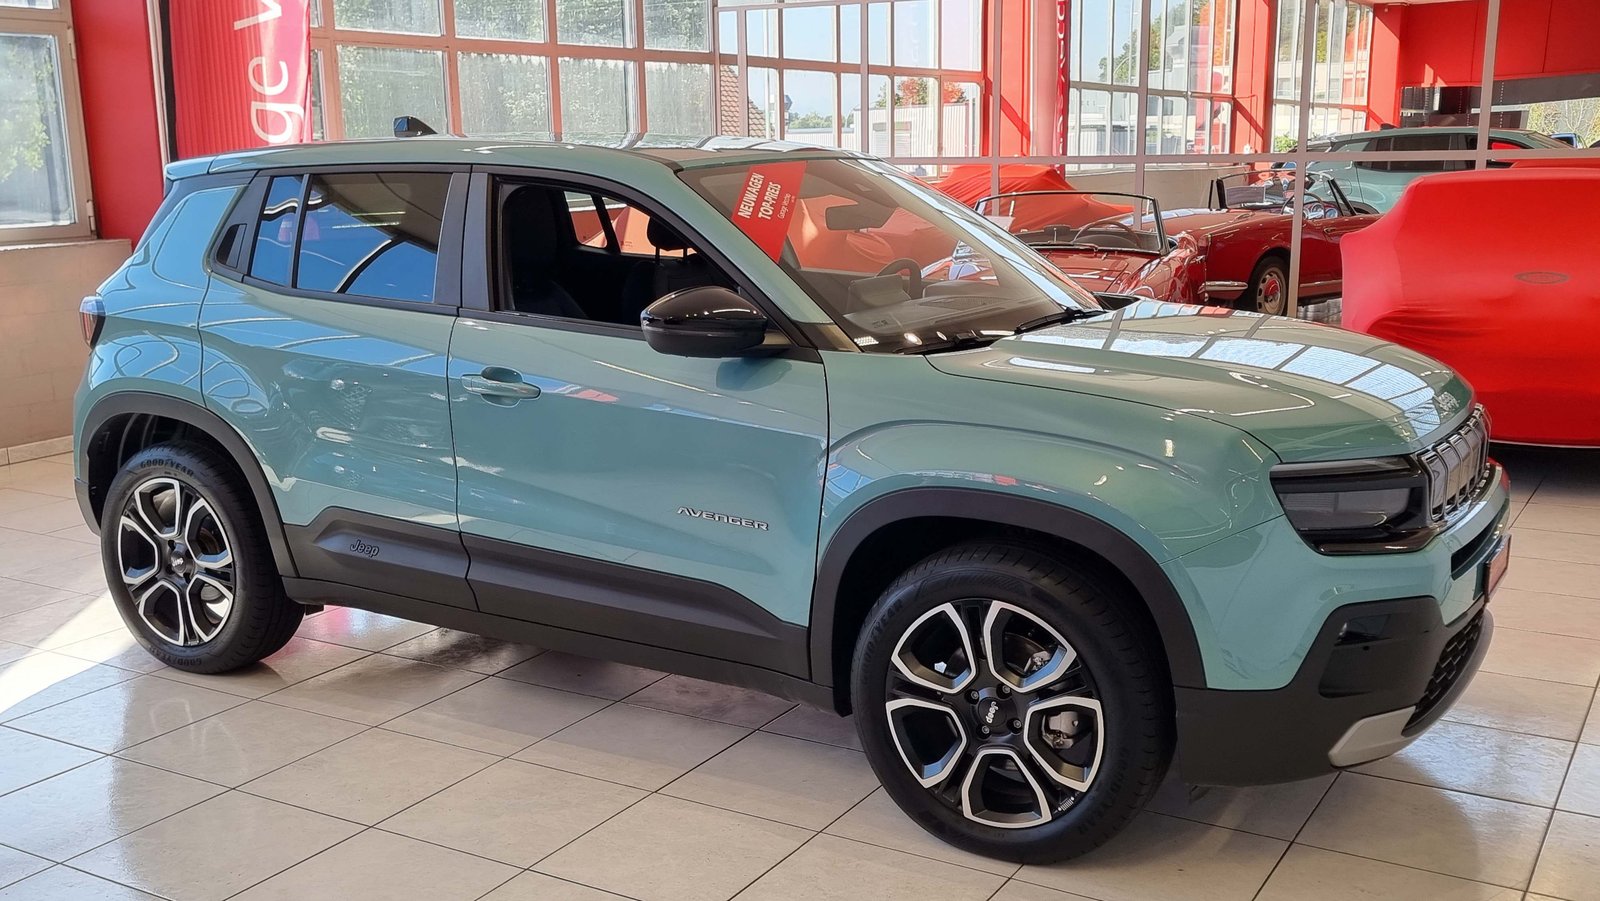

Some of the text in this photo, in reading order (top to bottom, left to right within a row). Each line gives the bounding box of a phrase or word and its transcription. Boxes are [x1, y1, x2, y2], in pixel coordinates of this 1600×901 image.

[738, 172, 764, 219] NEUWAGEN
[757, 181, 782, 220] TOP-PREIS
[140, 458, 195, 477] GOODYEAR
[676, 506, 769, 531] AVENGER
[350, 539, 380, 558] Jeep
[985, 701, 999, 724] Jeep
